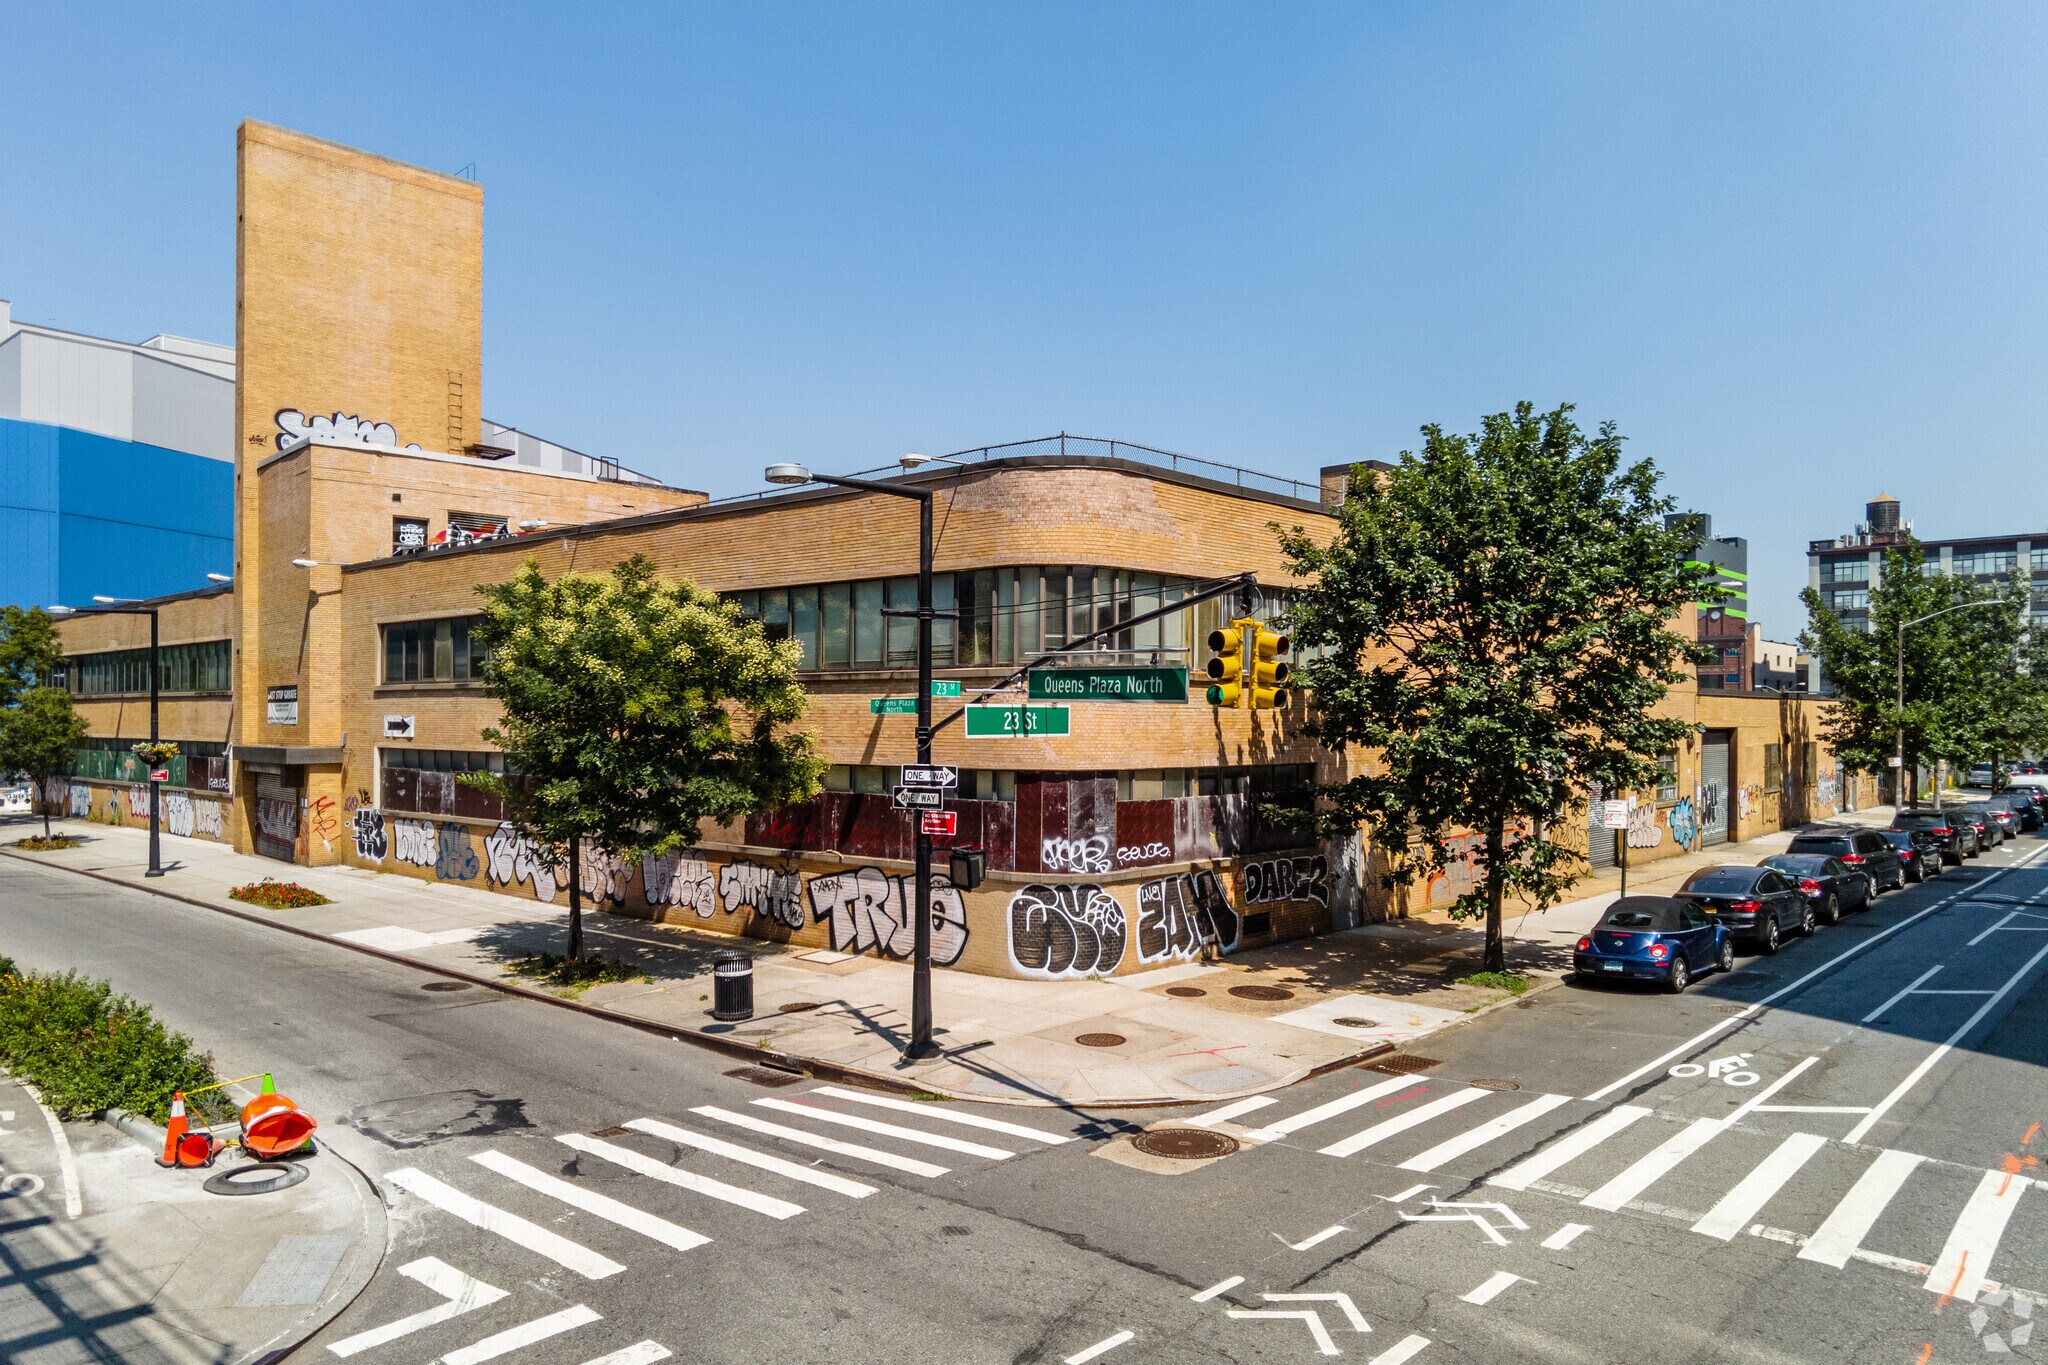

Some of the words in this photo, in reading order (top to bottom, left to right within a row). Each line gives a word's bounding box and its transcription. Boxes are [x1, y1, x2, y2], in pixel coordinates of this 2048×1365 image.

[936, 682, 947, 696] 23
[1044, 675, 1084, 694] Queens
[1089, 676, 1121, 694] Plaza
[1126, 675, 1163, 694] North
[898, 700, 915, 708] Plaza
[1003, 711, 1020, 731] 23
[1024, 711, 1038, 730] St
[907, 770, 924, 781] ONE
[932, 770, 950, 781] WAY
[900, 792, 915, 803] ONE
[920, 794, 936, 804] WAY
